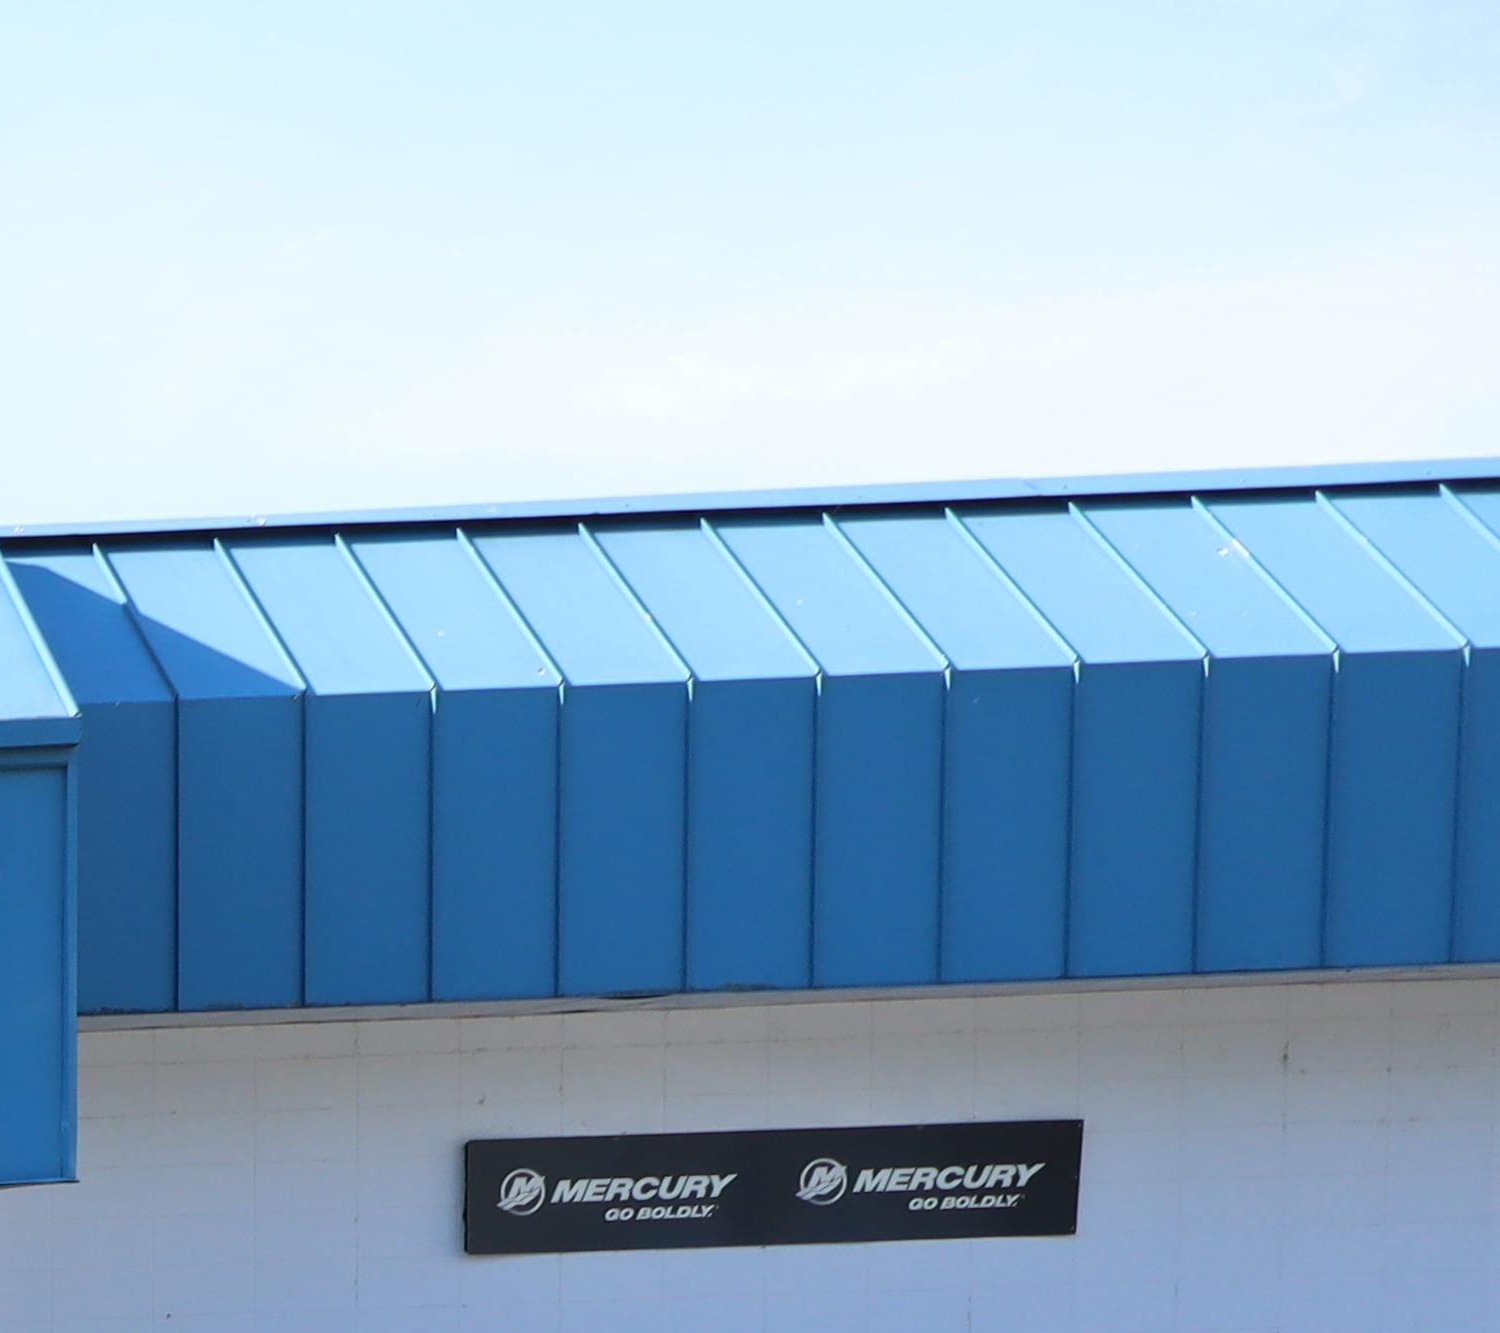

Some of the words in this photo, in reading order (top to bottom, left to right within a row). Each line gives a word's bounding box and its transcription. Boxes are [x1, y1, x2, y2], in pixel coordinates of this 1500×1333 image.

[550, 1173, 738, 1203] MERCURY
[851, 1162, 1046, 1194] MERCURY
[604, 1207, 637, 1222] GO
[908, 1196, 939, 1211] GO
